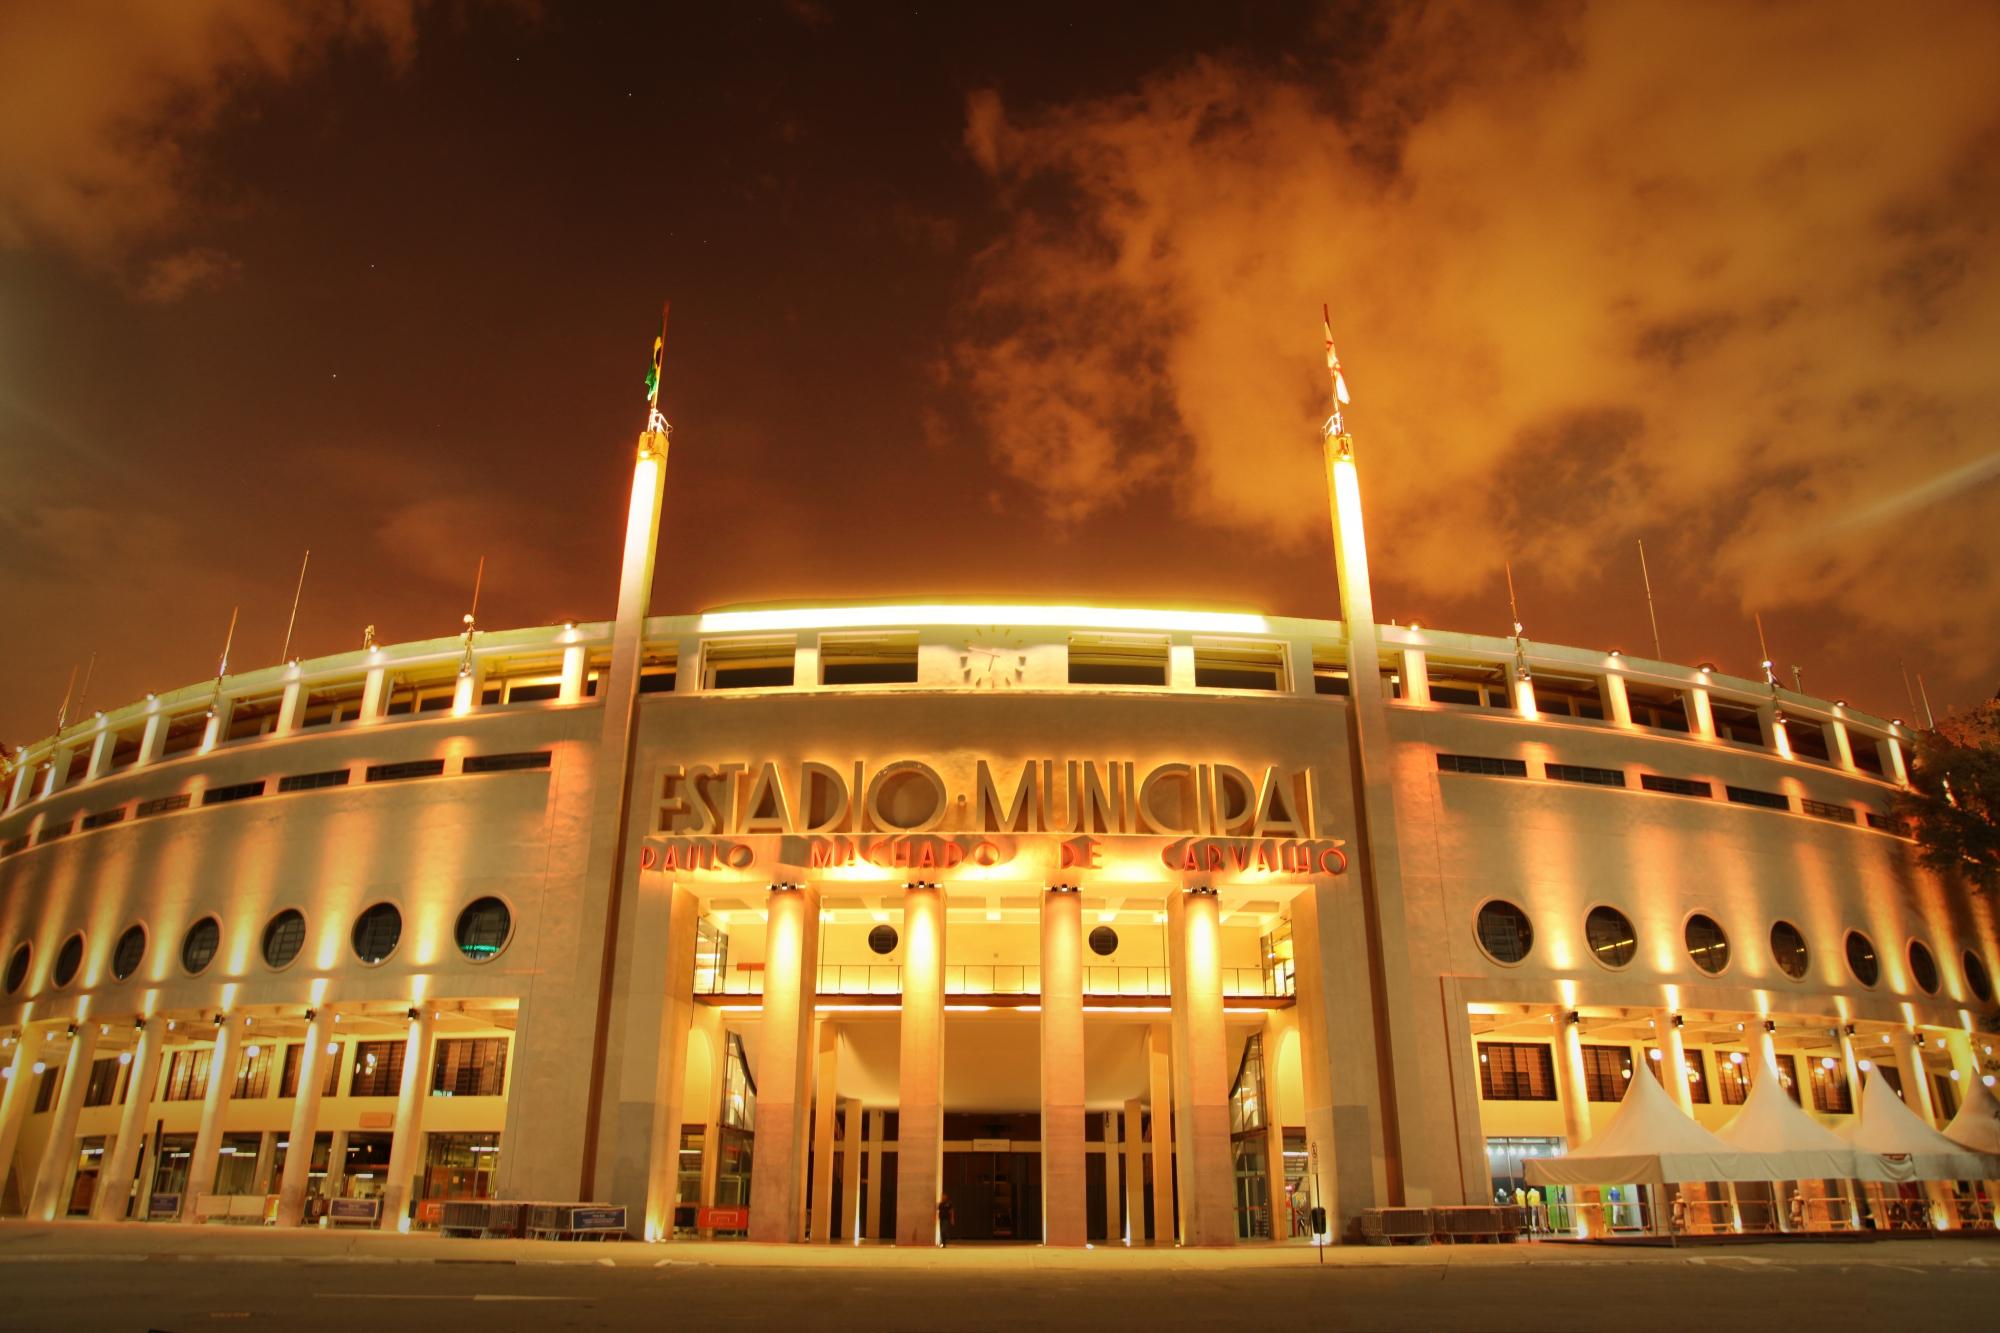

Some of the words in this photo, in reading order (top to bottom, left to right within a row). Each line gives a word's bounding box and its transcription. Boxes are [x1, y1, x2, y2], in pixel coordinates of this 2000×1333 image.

[652, 760, 948, 835] ESTADIO
[975, 760, 1324, 840] MUNICIPAL
[641, 842, 756, 873] PAULO
[810, 840, 1001, 869] MACHADO
[1060, 841, 1103, 869] DE
[1161, 842, 1349, 875] CARVALHO
